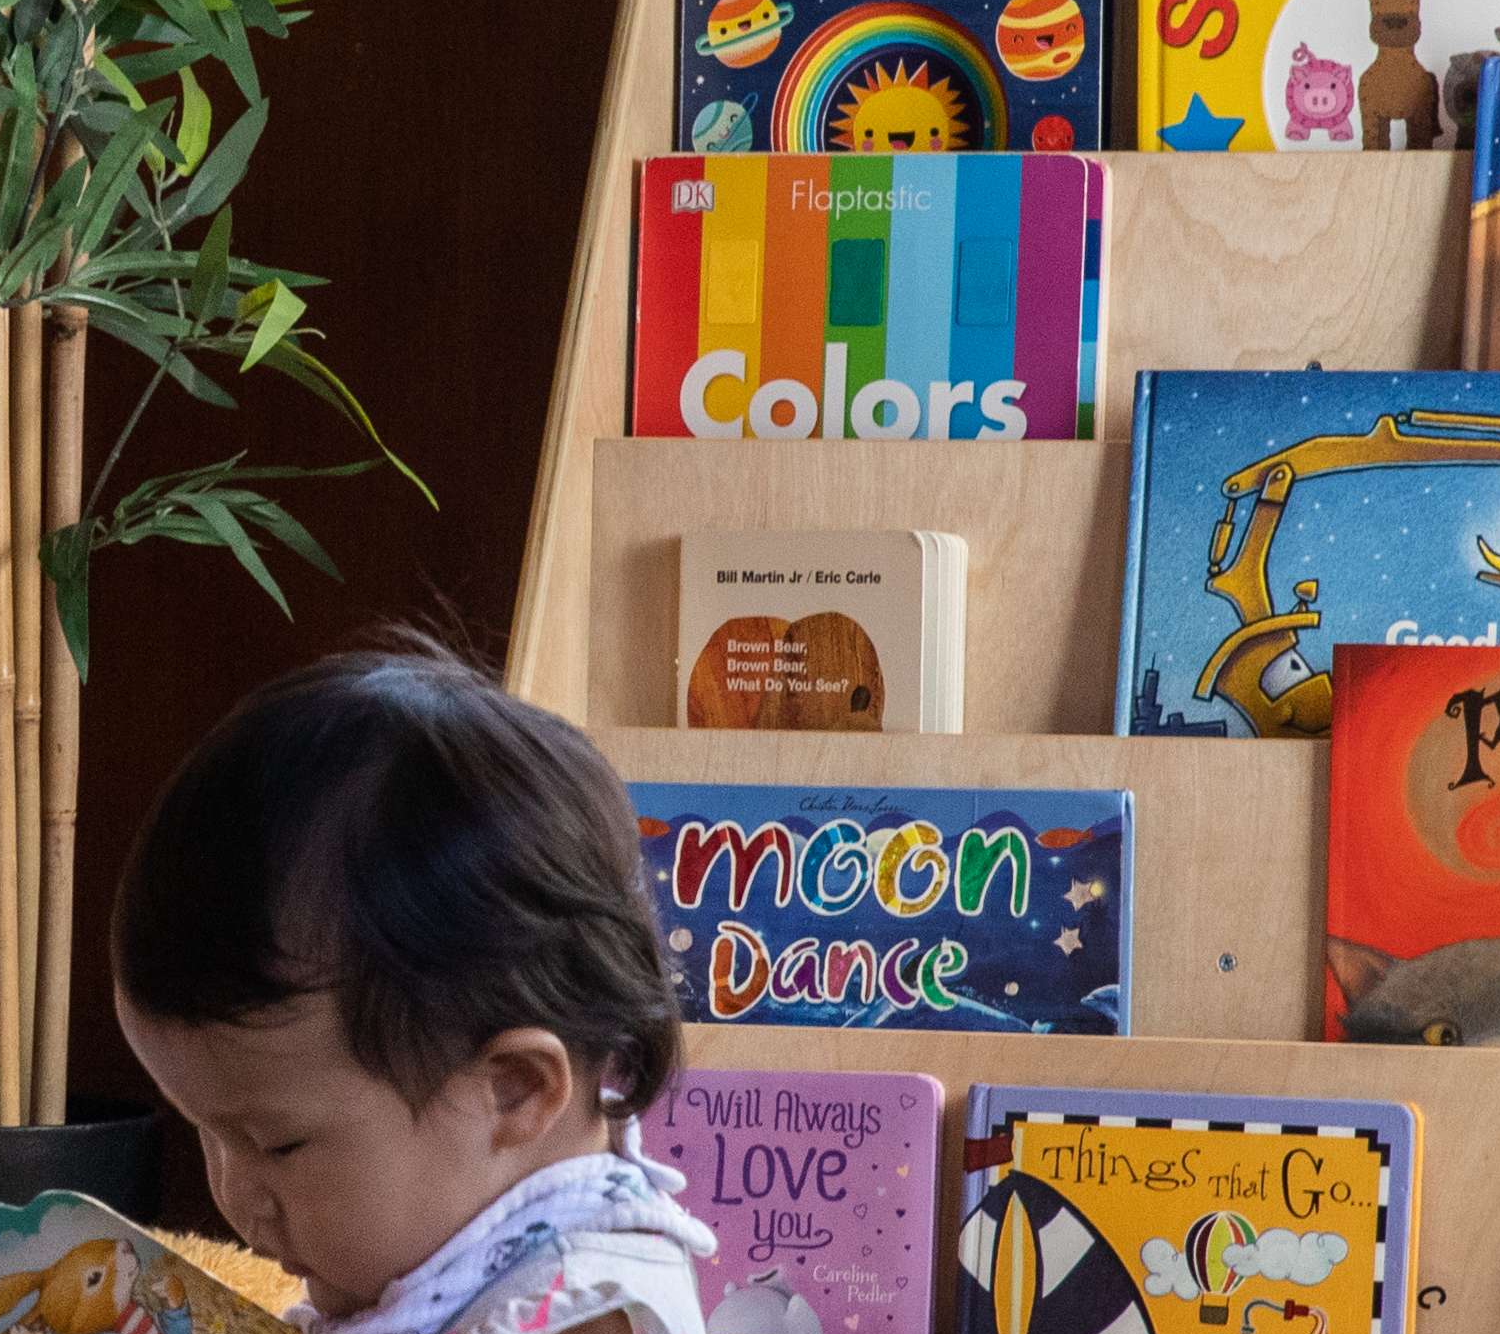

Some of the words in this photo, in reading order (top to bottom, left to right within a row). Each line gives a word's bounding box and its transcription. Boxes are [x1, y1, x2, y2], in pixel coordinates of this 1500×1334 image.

[675, 180, 711, 210] DK
[790, 180, 933, 221] Flaptastic
[679, 342, 1029, 440] Colors
[716, 570, 738, 584] Bill
[742, 570, 785, 584] Martin
[788, 570, 803, 584] Jr
[815, 570, 842, 584] Eric
[846, 570, 882, 585] Carle
[727, 639, 770, 654] Brown
[773, 639, 809, 656] Bear,
[727, 658, 770, 673] Brown
[773, 658, 808, 675] Bear,
[726, 678, 761, 692] What
[765, 678, 784, 692] Do
[787, 678, 812, 692] You
[815, 678, 850, 693] See?
[708, 920, 968, 1020] Dance
[687, 1087, 763, 1129] Will
[774, 1089, 882, 1150] Always
[1041, 1126, 1201, 1192] Things
[1208, 1161, 1269, 1201] That
[812, 1264, 880, 1285] Caroline
[847, 1284, 898, 1305] Pedler
